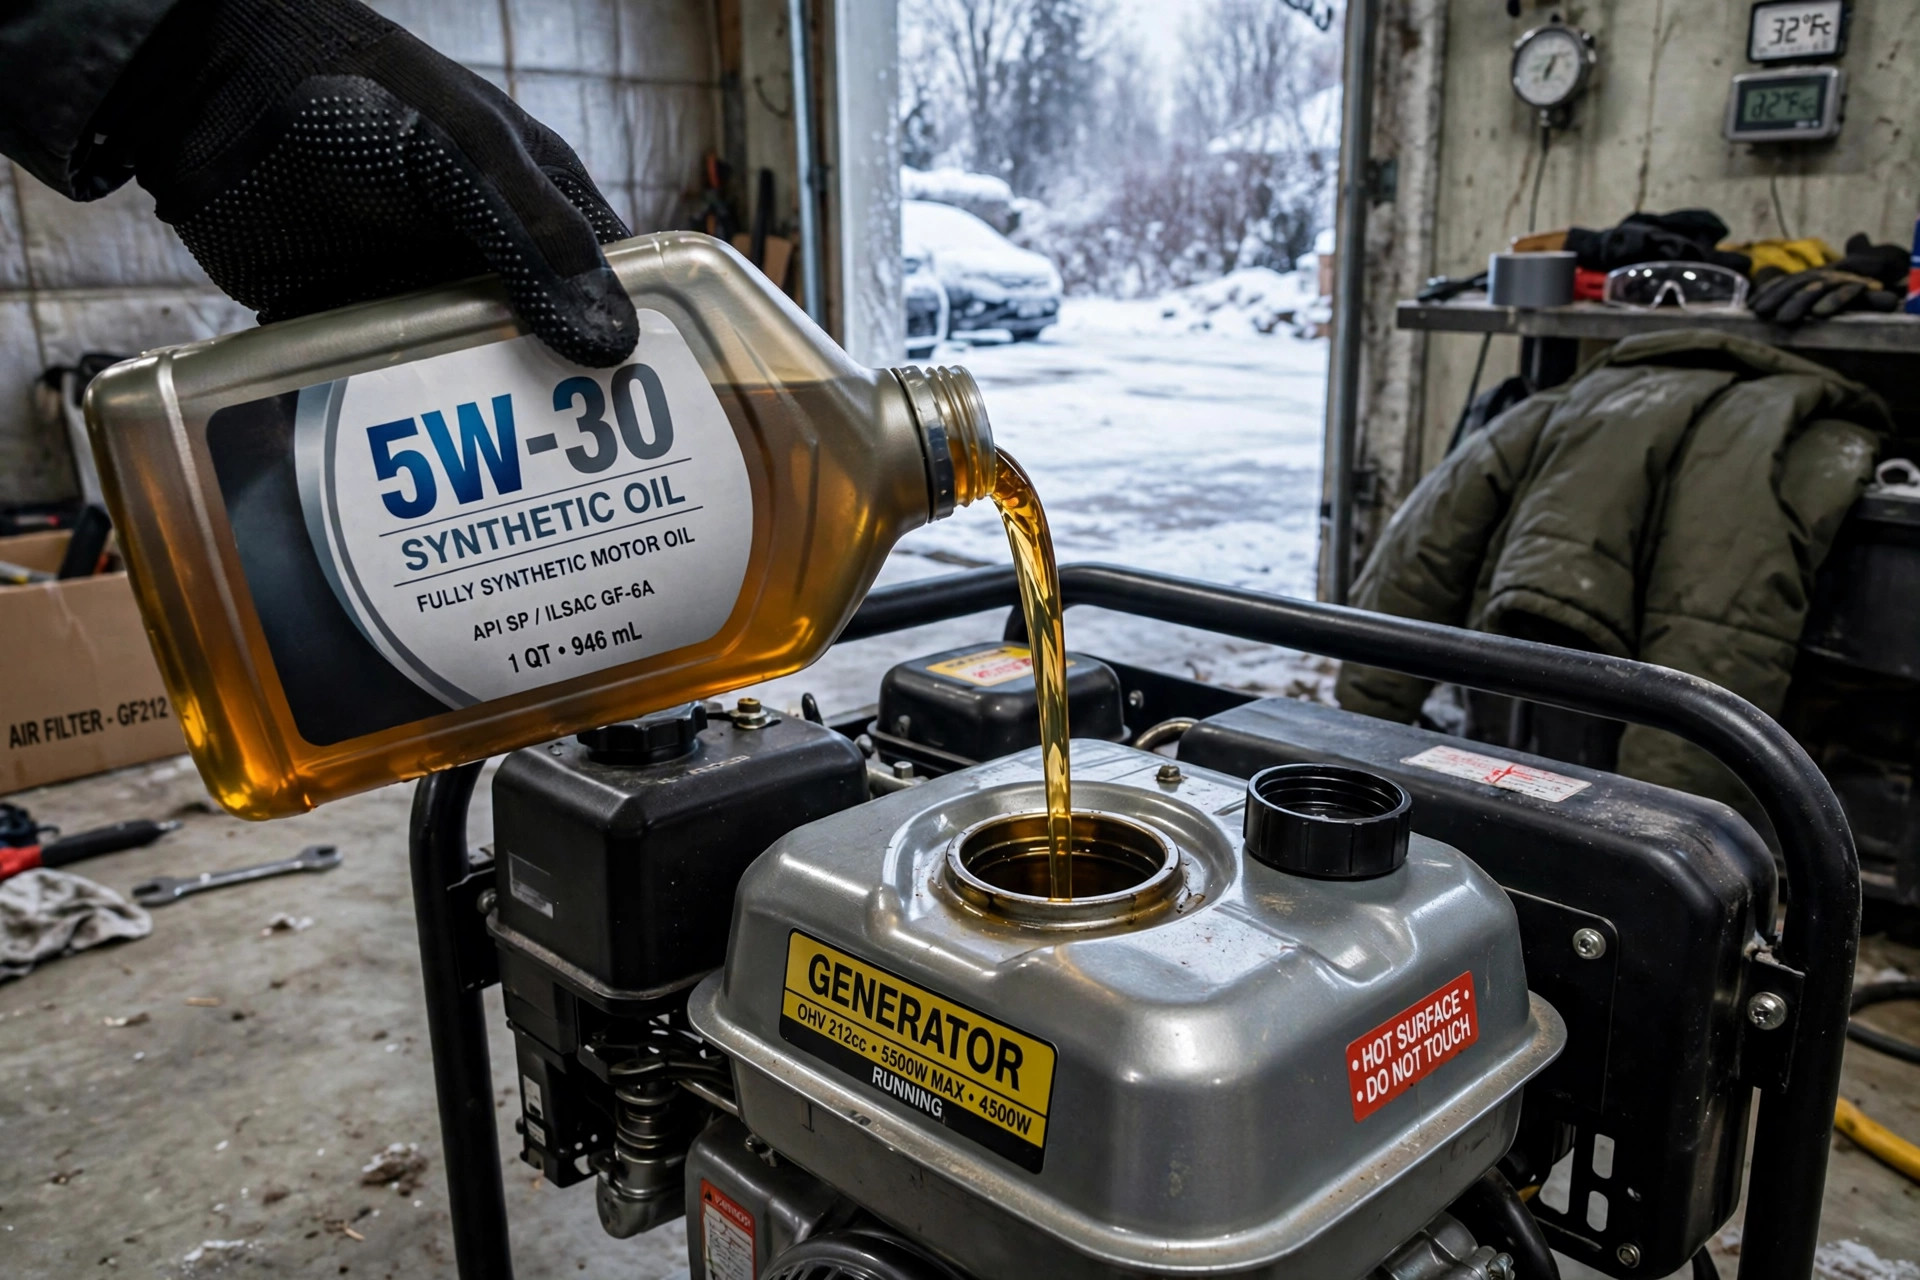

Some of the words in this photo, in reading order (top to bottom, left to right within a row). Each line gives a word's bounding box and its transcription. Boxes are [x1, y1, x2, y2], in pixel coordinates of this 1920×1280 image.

[366, 363, 674, 519] 5W-30
[401, 491, 615, 571] SYNTHETIC
[623, 475, 686, 514] OIL
[417, 582, 475, 612] FULLY
[480, 554, 587, 596] SYNTHETIC
[591, 535, 660, 567] MOTOR
[663, 527, 695, 547] OIL
[473, 619, 502, 641] API
[506, 612, 530, 632] SP
[545, 594, 597, 623] ILSAC
[601, 580, 655, 606] GF-6A
[508, 654, 520, 673] 1
[525, 644, 552, 669] QT
[571, 631, 607, 656] 946
[612, 621, 642, 645] mL
[9, 721, 40, 749] AIR
[43, 709, 104, 742] FILTER
[117, 697, 169, 726] GF212
[808, 953, 1024, 1092] GENERATOR
[1362, 1031, 1392, 1072] HOT
[1397, 989, 1461, 1050] SURFACE
[1366, 1069, 1389, 1103] DO
[1392, 1046, 1421, 1086] NOT
[1424, 1013, 1471, 1062] TOUCH
[797, 1003, 827, 1030] OHV
[828, 1019, 867, 1052] 212cc
[881, 1045, 928, 1083] 5500W
[931, 1070, 966, 1103] MAX
[979, 1095, 1032, 1135] 4500W
[872, 1066, 943, 1118] RUNNING
